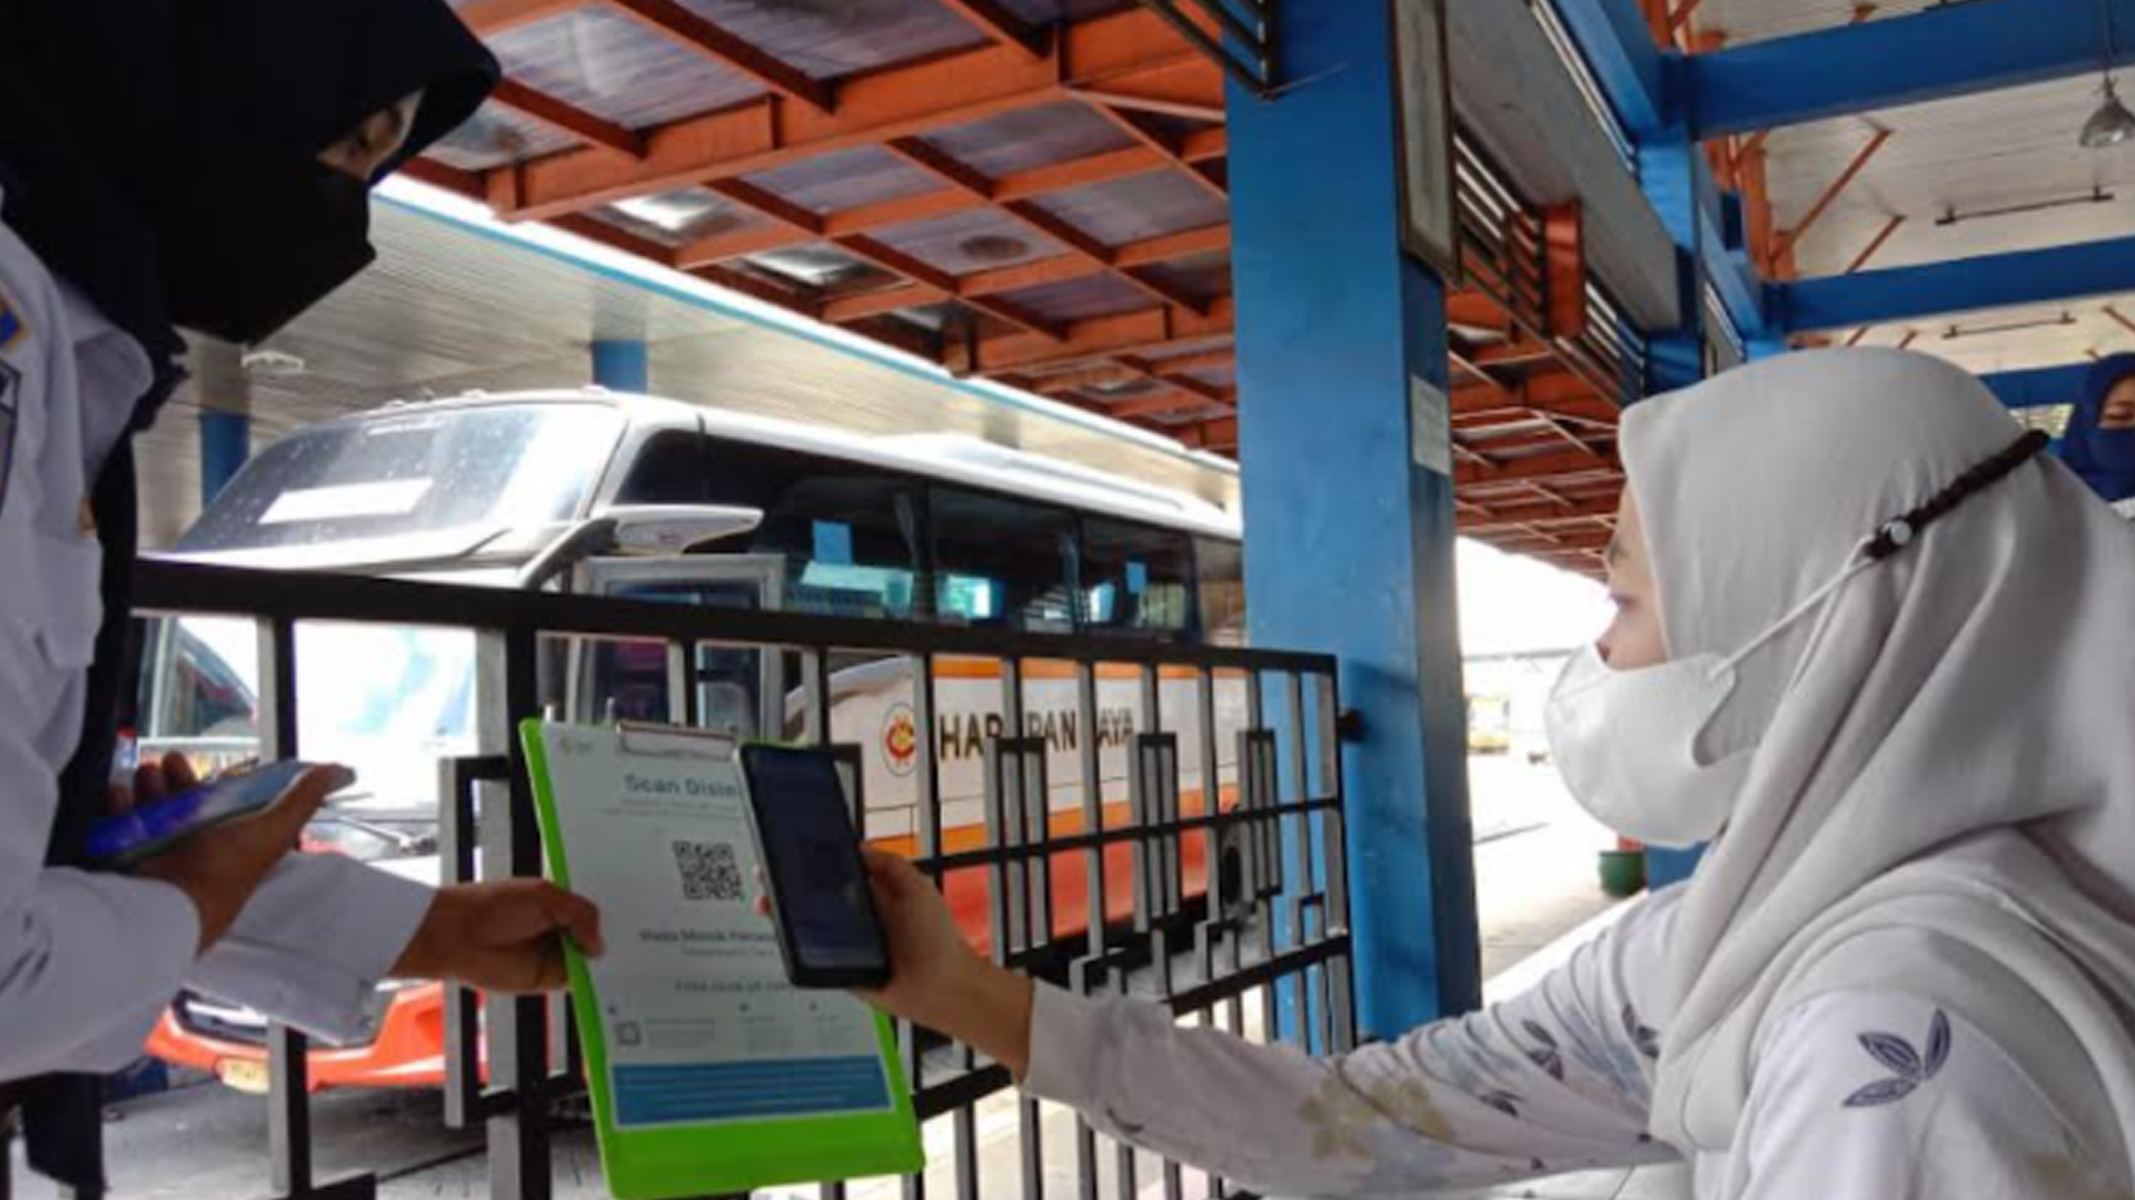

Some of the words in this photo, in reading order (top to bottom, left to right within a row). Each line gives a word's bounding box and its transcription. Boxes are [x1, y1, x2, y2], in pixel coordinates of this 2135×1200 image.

[940, 711, 1077, 760] HARPAN
[1092, 708, 1133, 748] AYA
[624, 773, 681, 794] Scan
[684, 778, 739, 797] Disin
